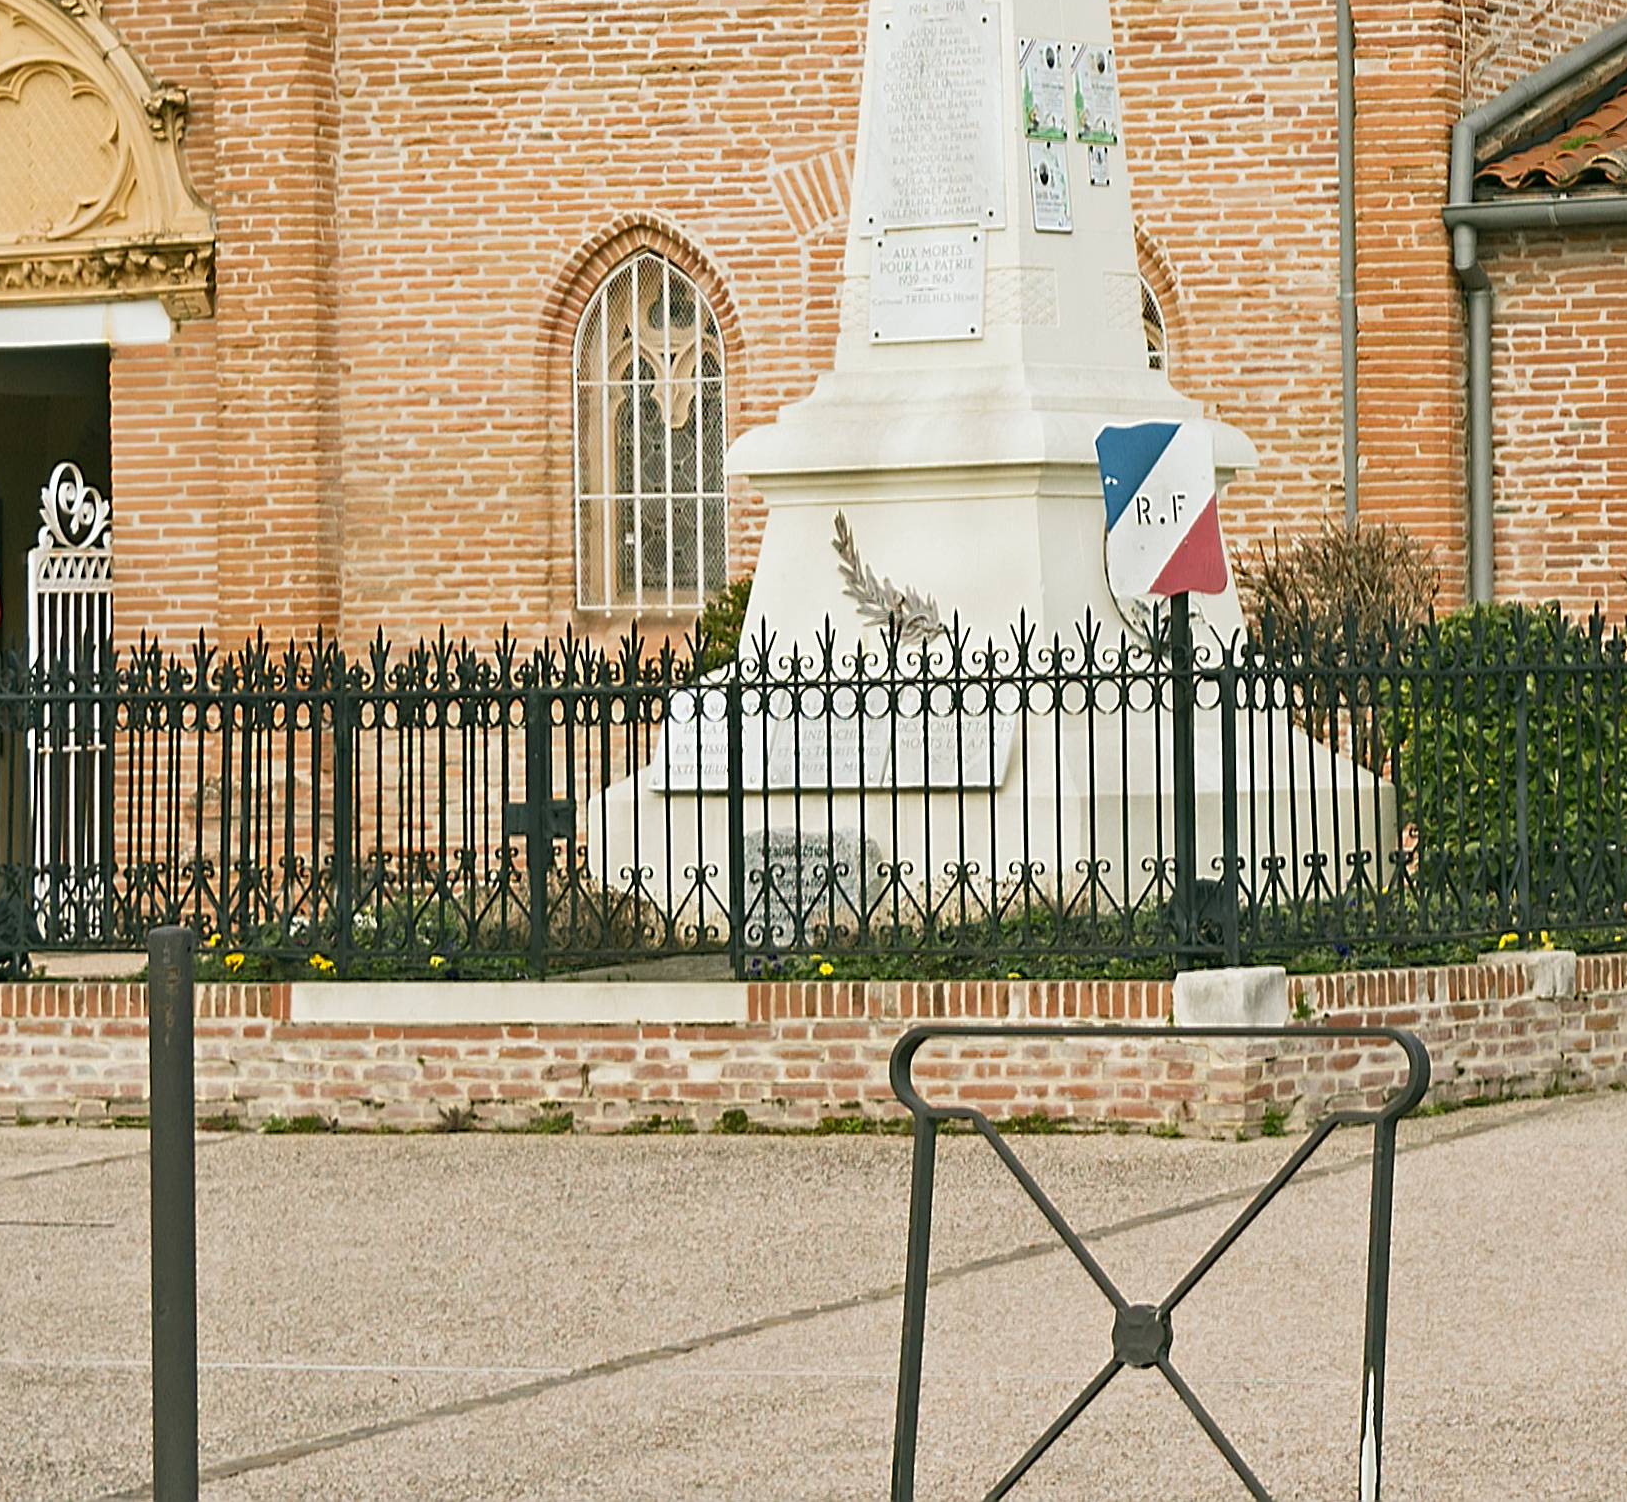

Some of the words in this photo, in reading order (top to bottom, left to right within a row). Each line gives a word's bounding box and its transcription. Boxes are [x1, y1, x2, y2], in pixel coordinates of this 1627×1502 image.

[908, 1, 928, 16] 1914
[892, 245, 918, 260] AUX
[921, 243, 964, 259] MORTS
[879, 260, 913, 275] POUR
[915, 259, 931, 273] LA
[933, 257, 974, 272] PATRIE
[898, 273, 920, 287] 1939
[932, 273, 955, 285] 1945
[1136, 494, 1186, 526] R.F
